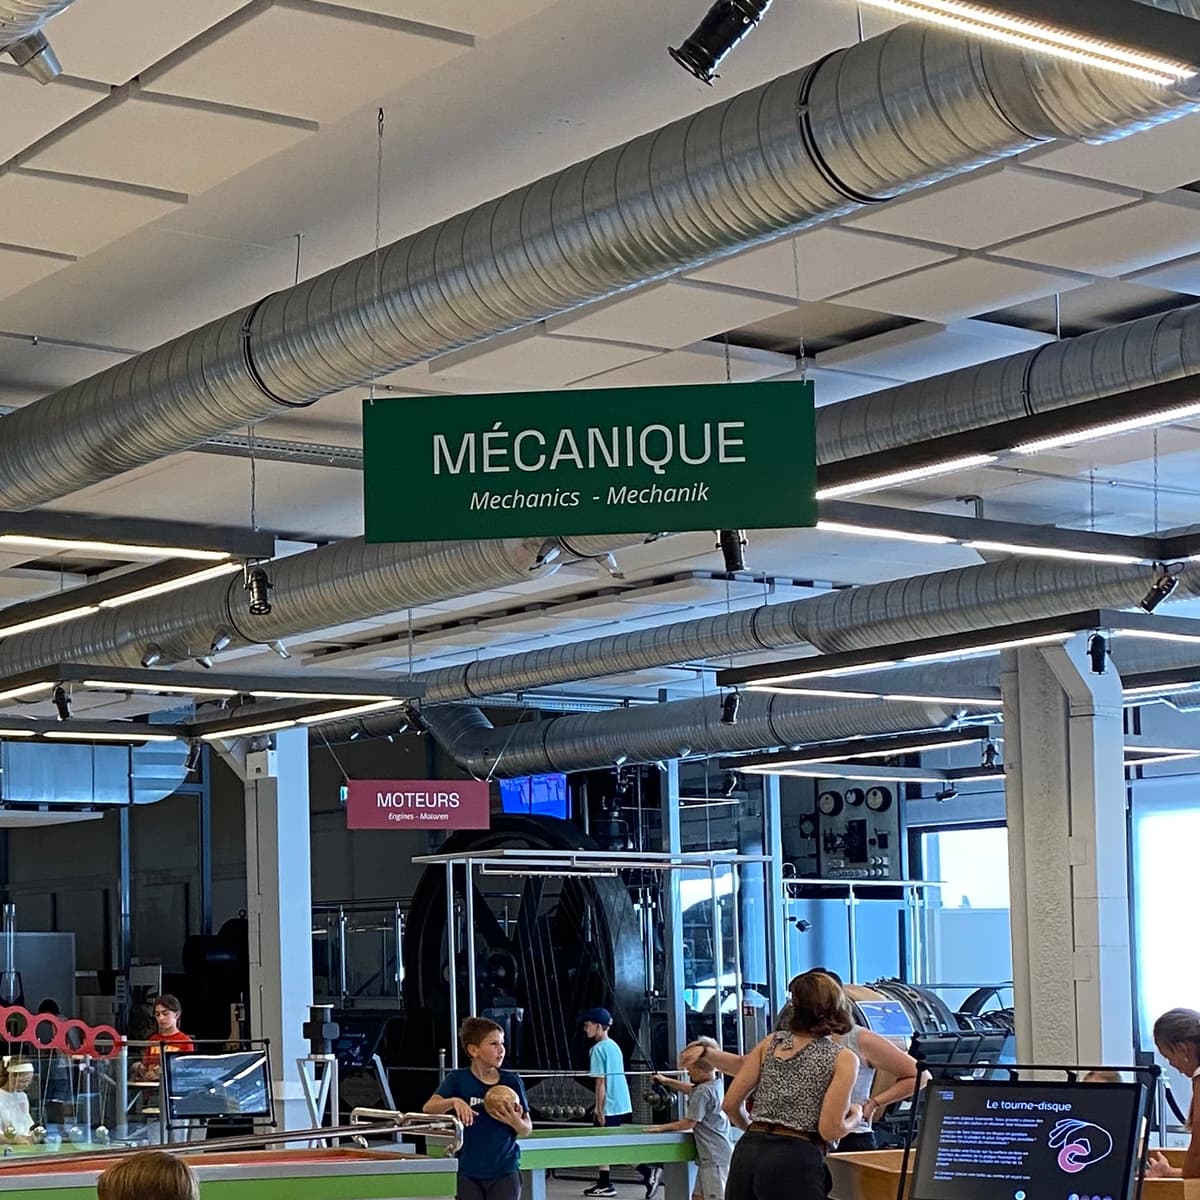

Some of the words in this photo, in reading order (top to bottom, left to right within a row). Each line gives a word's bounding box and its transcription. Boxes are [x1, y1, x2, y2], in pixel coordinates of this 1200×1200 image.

[433, 421, 747, 475] MÉCANIQUE
[469, 489, 580, 511] Mechanics
[606, 482, 710, 506] Mechanik
[377, 792, 460, 808] MOTEURS
[388, 811, 415, 822] Engines
[419, 812, 449, 821] Motoren
[986, 1099, 999, 1110] Le
